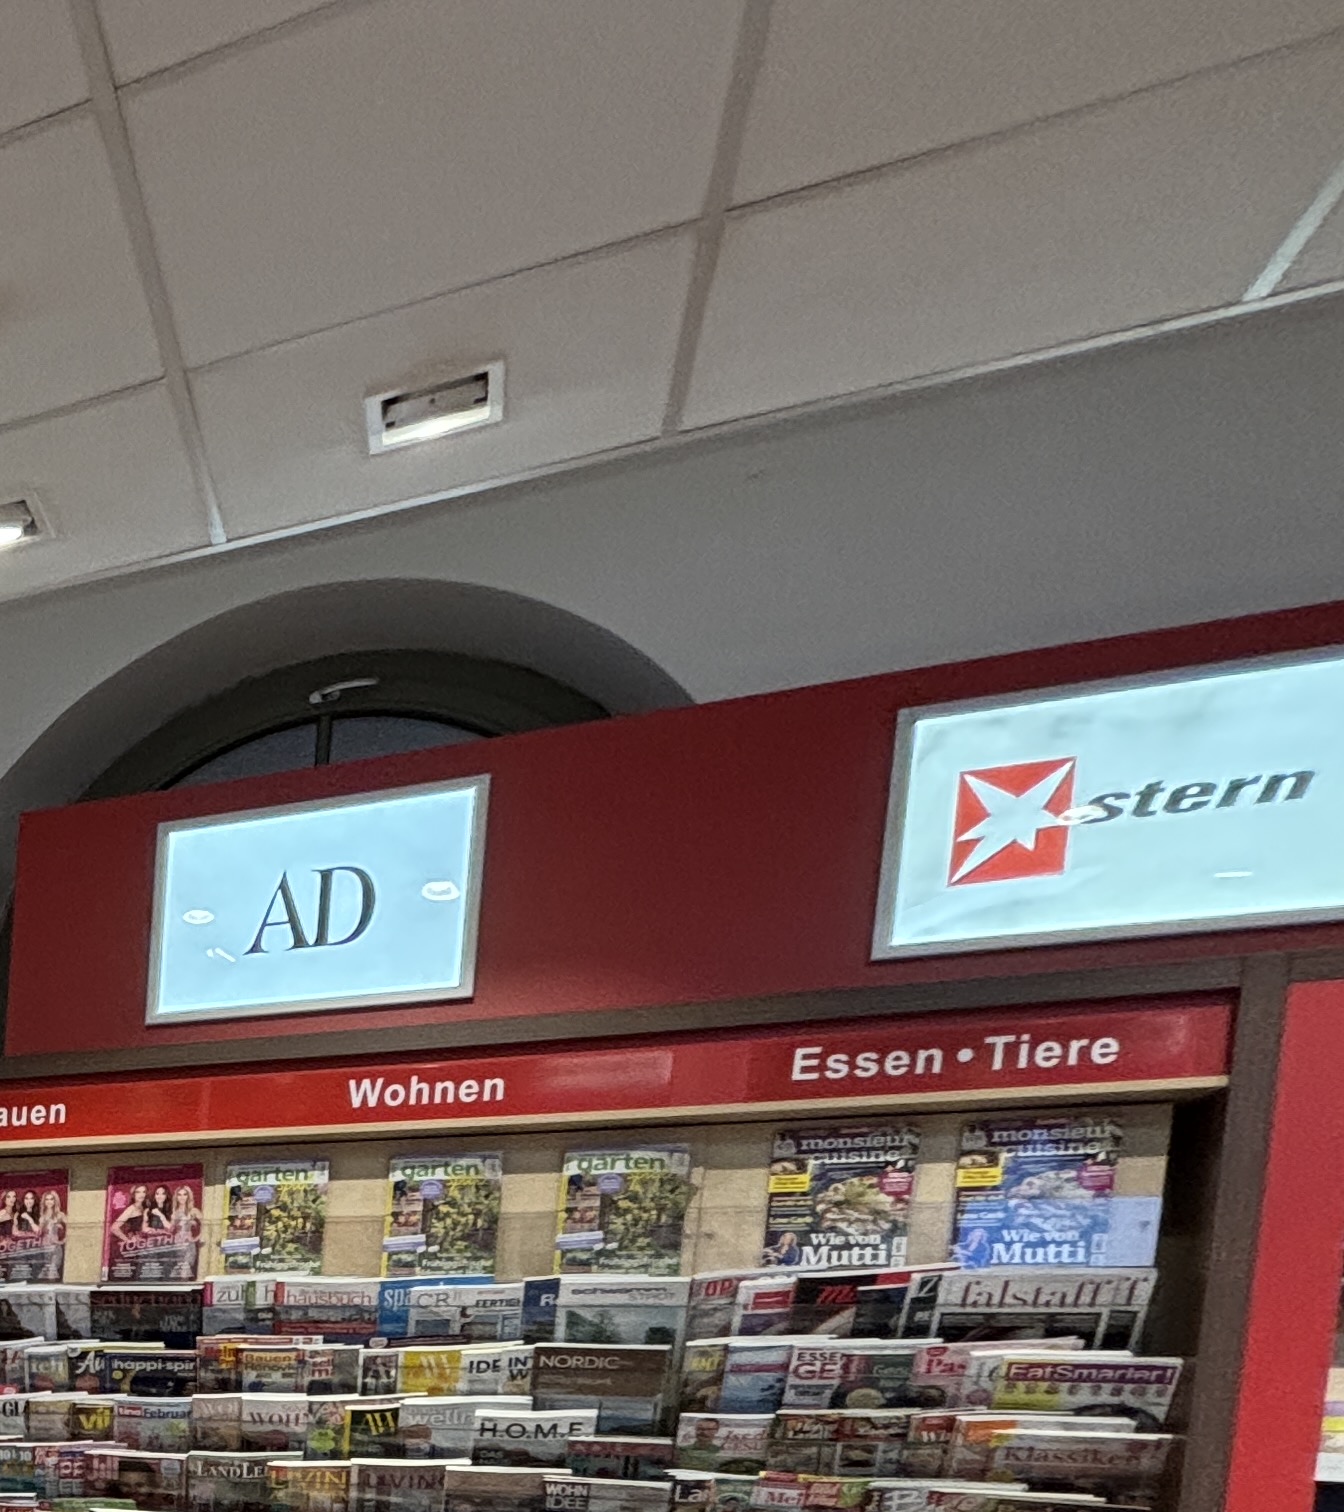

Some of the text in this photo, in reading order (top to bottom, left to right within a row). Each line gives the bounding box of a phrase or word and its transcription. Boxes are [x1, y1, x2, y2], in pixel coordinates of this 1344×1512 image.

[1084, 766, 1317, 825] stern
[241, 864, 377, 957] AD
[790, 1033, 1121, 1082] Essen Tiere
[347, 1074, 506, 1110] Wohnen
[799, 1131, 914, 1152] monsieur
[576, 1152, 667, 1178] garten
[799, 1243, 890, 1267] Mutti
[991, 1240, 1087, 1265] Mutti
